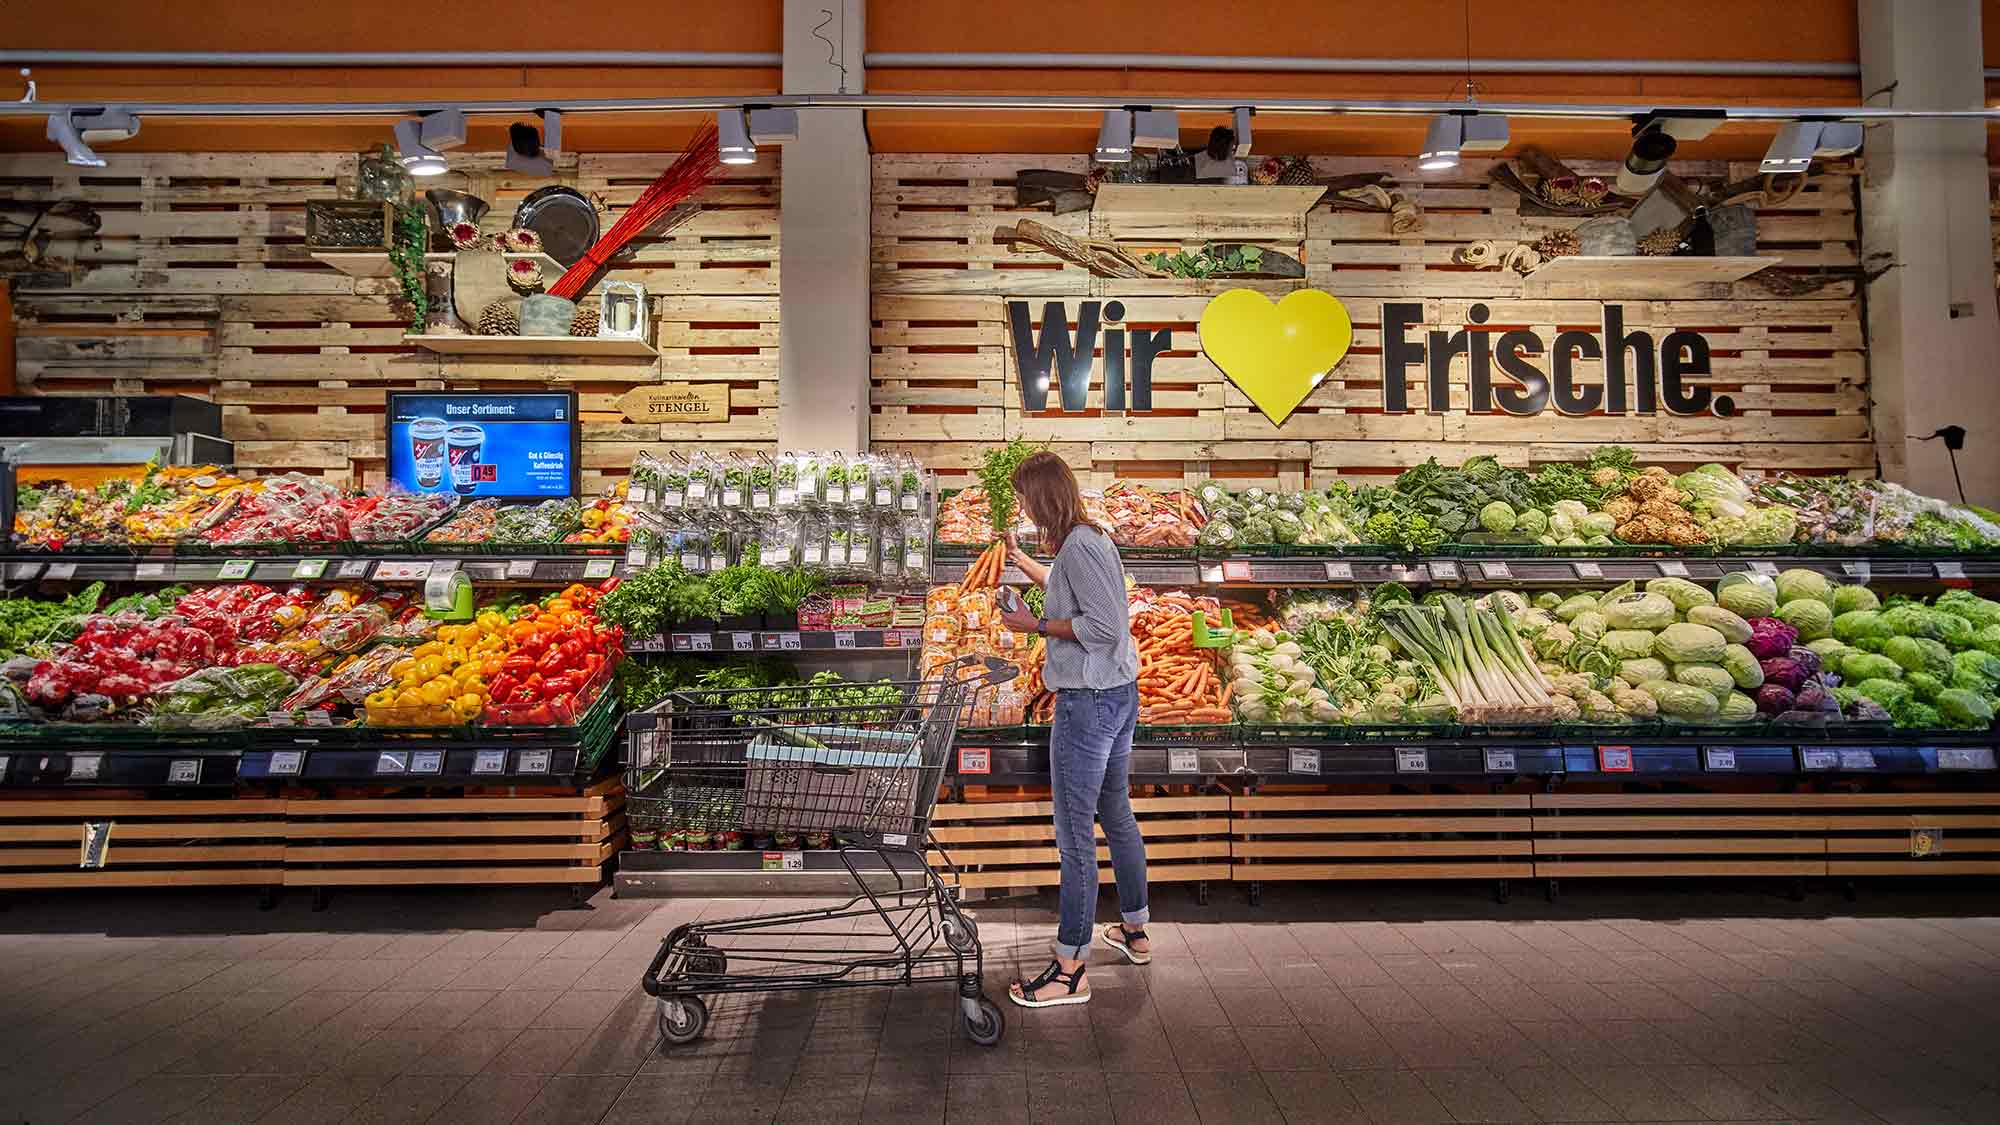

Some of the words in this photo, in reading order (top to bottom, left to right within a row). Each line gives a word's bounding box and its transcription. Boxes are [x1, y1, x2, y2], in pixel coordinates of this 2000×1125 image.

[1006, 300, 1172, 412] Wir
[1382, 302, 1735, 418] Frische.
[446, 403, 470, 414] Unser
[472, 403, 515, 414] Sortiment:
[648, 403, 710, 412] STENGEL
[649, 642, 664, 650] 0.79
[696, 642, 711, 650] 0.79
[737, 641, 752, 649] 0.79
[785, 641, 800, 649] 0.79
[787, 860, 802, 868] 1.29
